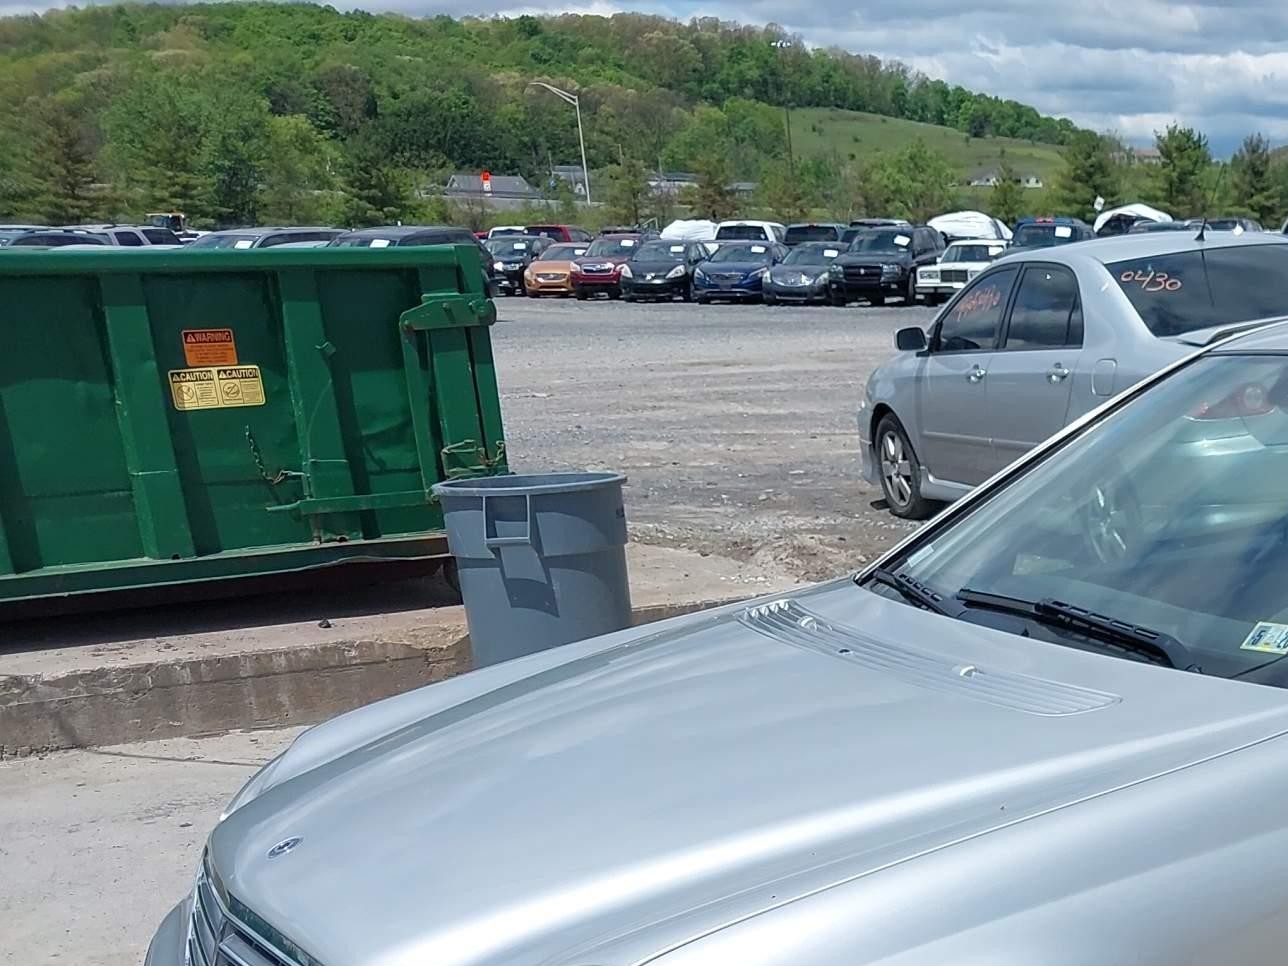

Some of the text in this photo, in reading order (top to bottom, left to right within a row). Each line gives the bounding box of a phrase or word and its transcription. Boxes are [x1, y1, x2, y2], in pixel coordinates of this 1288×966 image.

[1120, 269, 1182, 292] 0430
[195, 332, 231, 342] WARNING
[180, 372, 213, 381] CAUTION
[226, 369, 258, 378] CAUTION
[1251, 630, 1265, 646] 5
